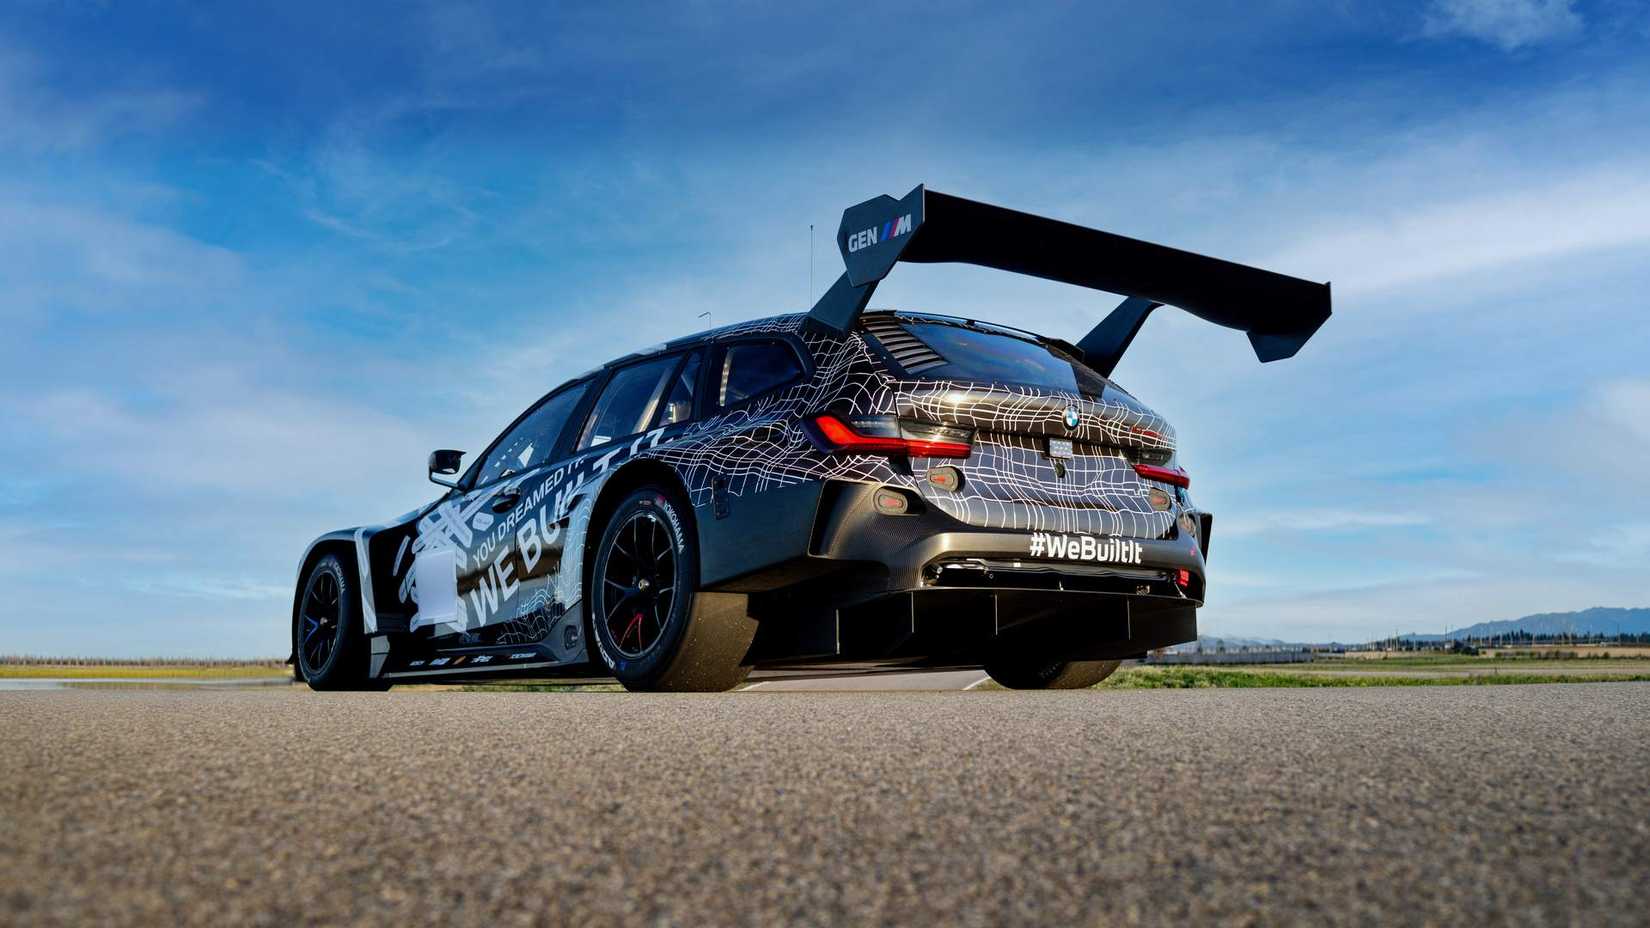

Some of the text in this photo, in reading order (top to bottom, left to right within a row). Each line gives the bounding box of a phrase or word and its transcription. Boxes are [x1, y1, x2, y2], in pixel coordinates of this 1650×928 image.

[848, 226, 878, 253] GEN
[473, 531, 496, 568] YOU
[498, 467, 564, 541] DREAMED
[1029, 532, 1143, 564] #WeBuiltIt
[470, 545, 520, 627] WE
